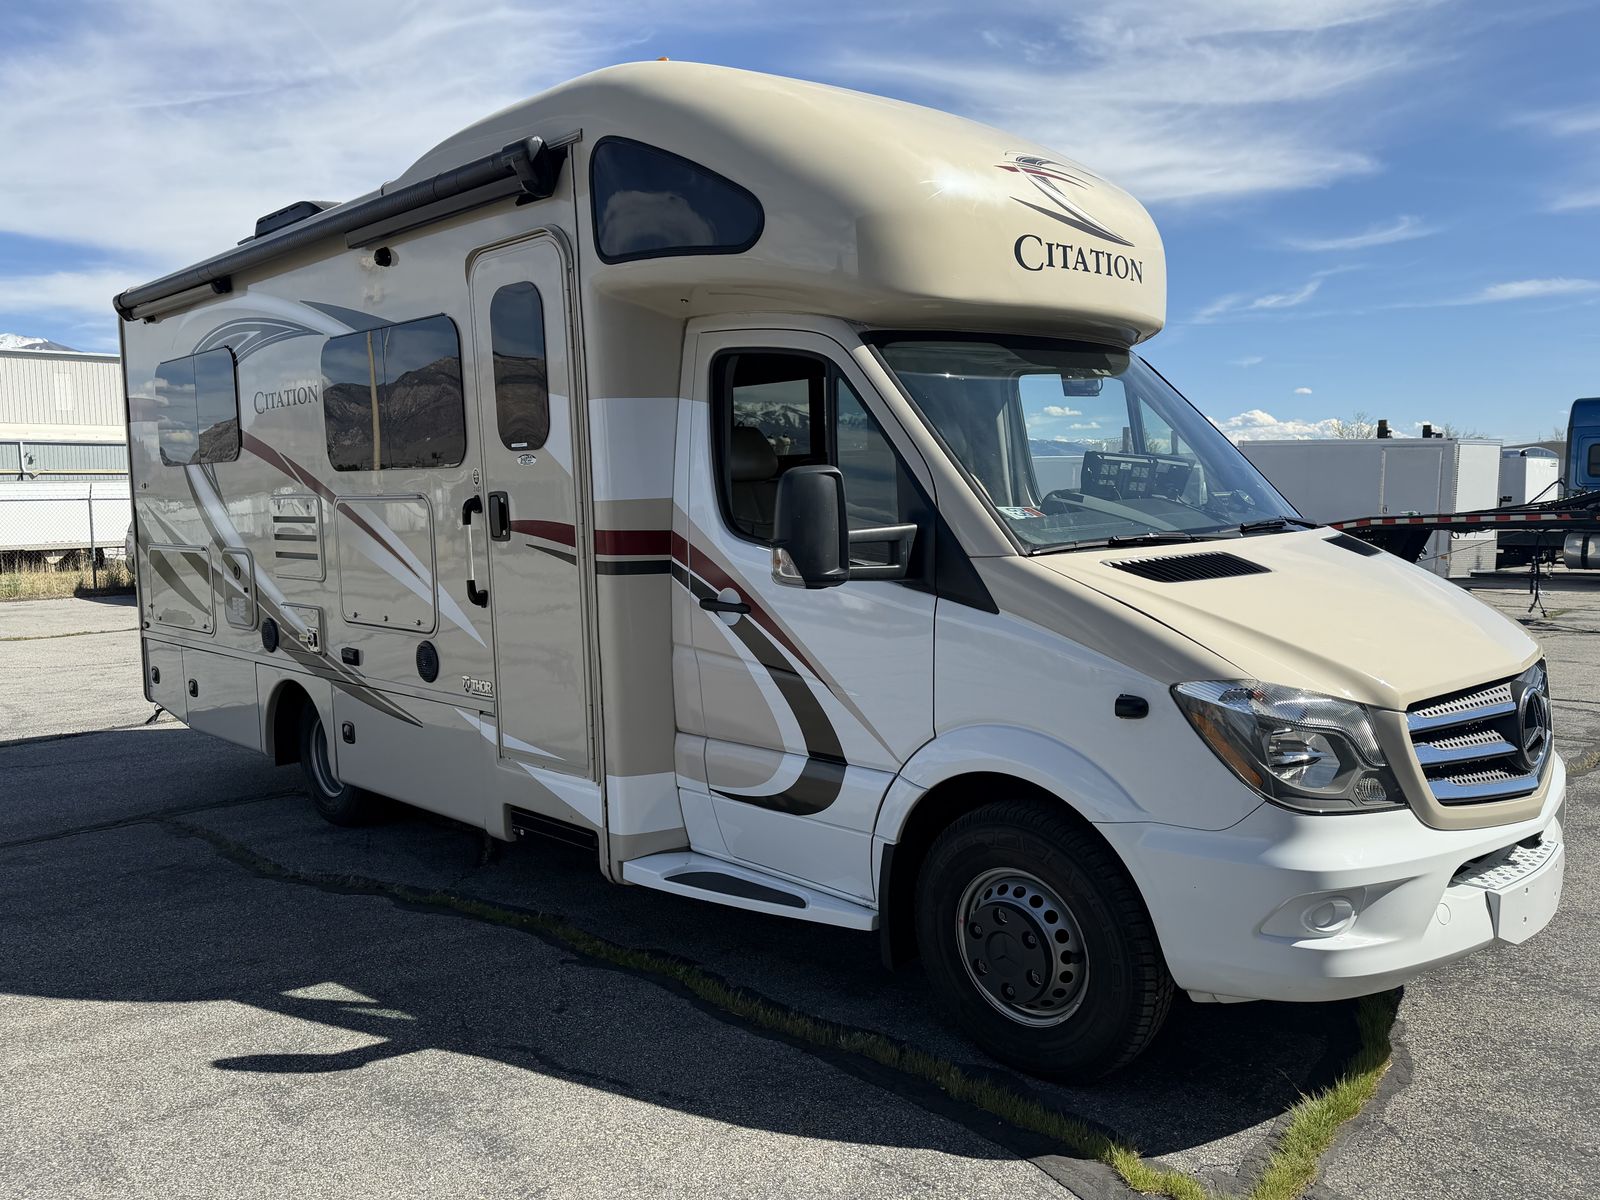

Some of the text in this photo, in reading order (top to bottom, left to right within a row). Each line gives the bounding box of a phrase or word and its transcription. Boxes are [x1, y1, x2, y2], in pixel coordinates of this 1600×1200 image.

[1013, 234, 1143, 284] CITATION
[253, 384, 318, 414] CITATION
[470, 679, 493, 693] THOR
